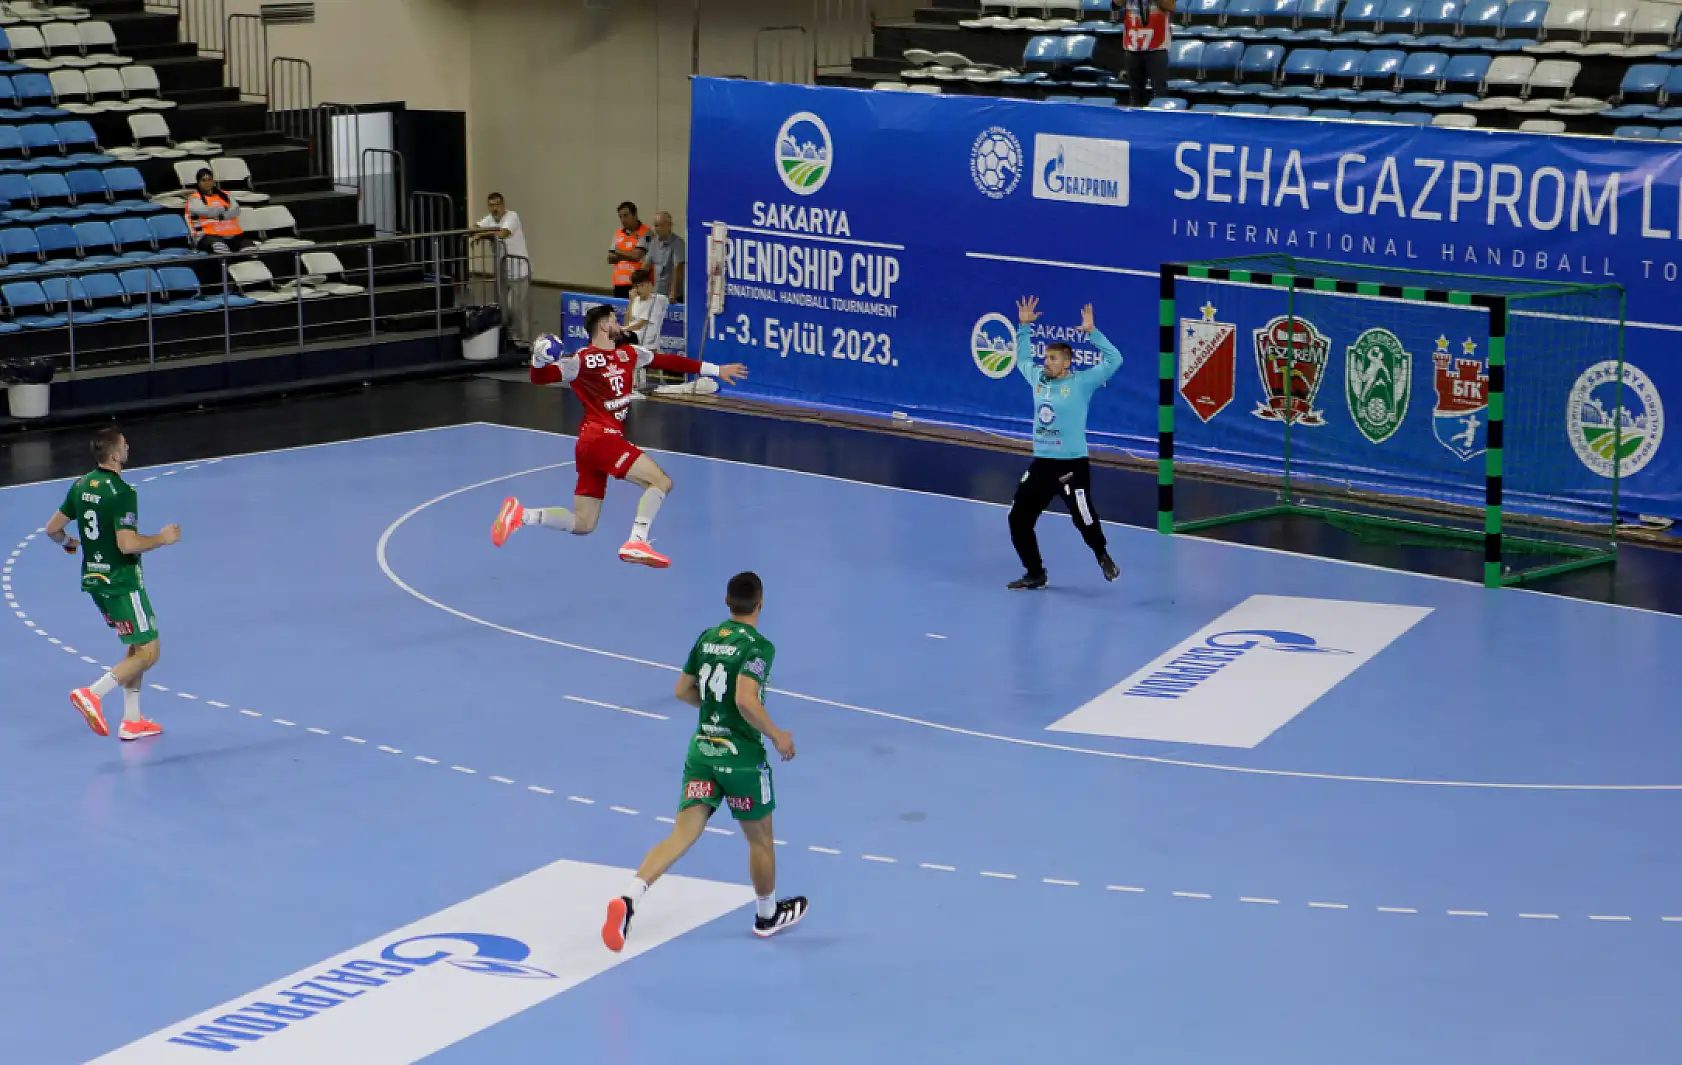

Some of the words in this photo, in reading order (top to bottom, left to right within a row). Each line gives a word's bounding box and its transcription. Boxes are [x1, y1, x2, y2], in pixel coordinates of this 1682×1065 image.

[1174, 141, 1620, 235] SEHA-GAZPROM
[752, 201, 851, 236] SAKARYA
[1172, 218, 1418, 258] INTERNATIONAL
[1441, 243, 1615, 276] HANDBALL
[850, 252, 900, 298] CUP
[724, 284, 778, 302] ERNATIONAL
[780, 291, 829, 310] HANDBALL
[831, 297, 899, 318] TOURNAMENT
[585, 353, 607, 369] 89
[765, 317, 826, 358] Eylül
[832, 327, 899, 367] 2023.
[1453, 379, 1483, 400] БГК
[83, 508, 100, 541] 3
[699, 662, 727, 703] 14
[1122, 647, 1243, 699] GAZPROM
[167, 959, 416, 1053] GAZPROM
